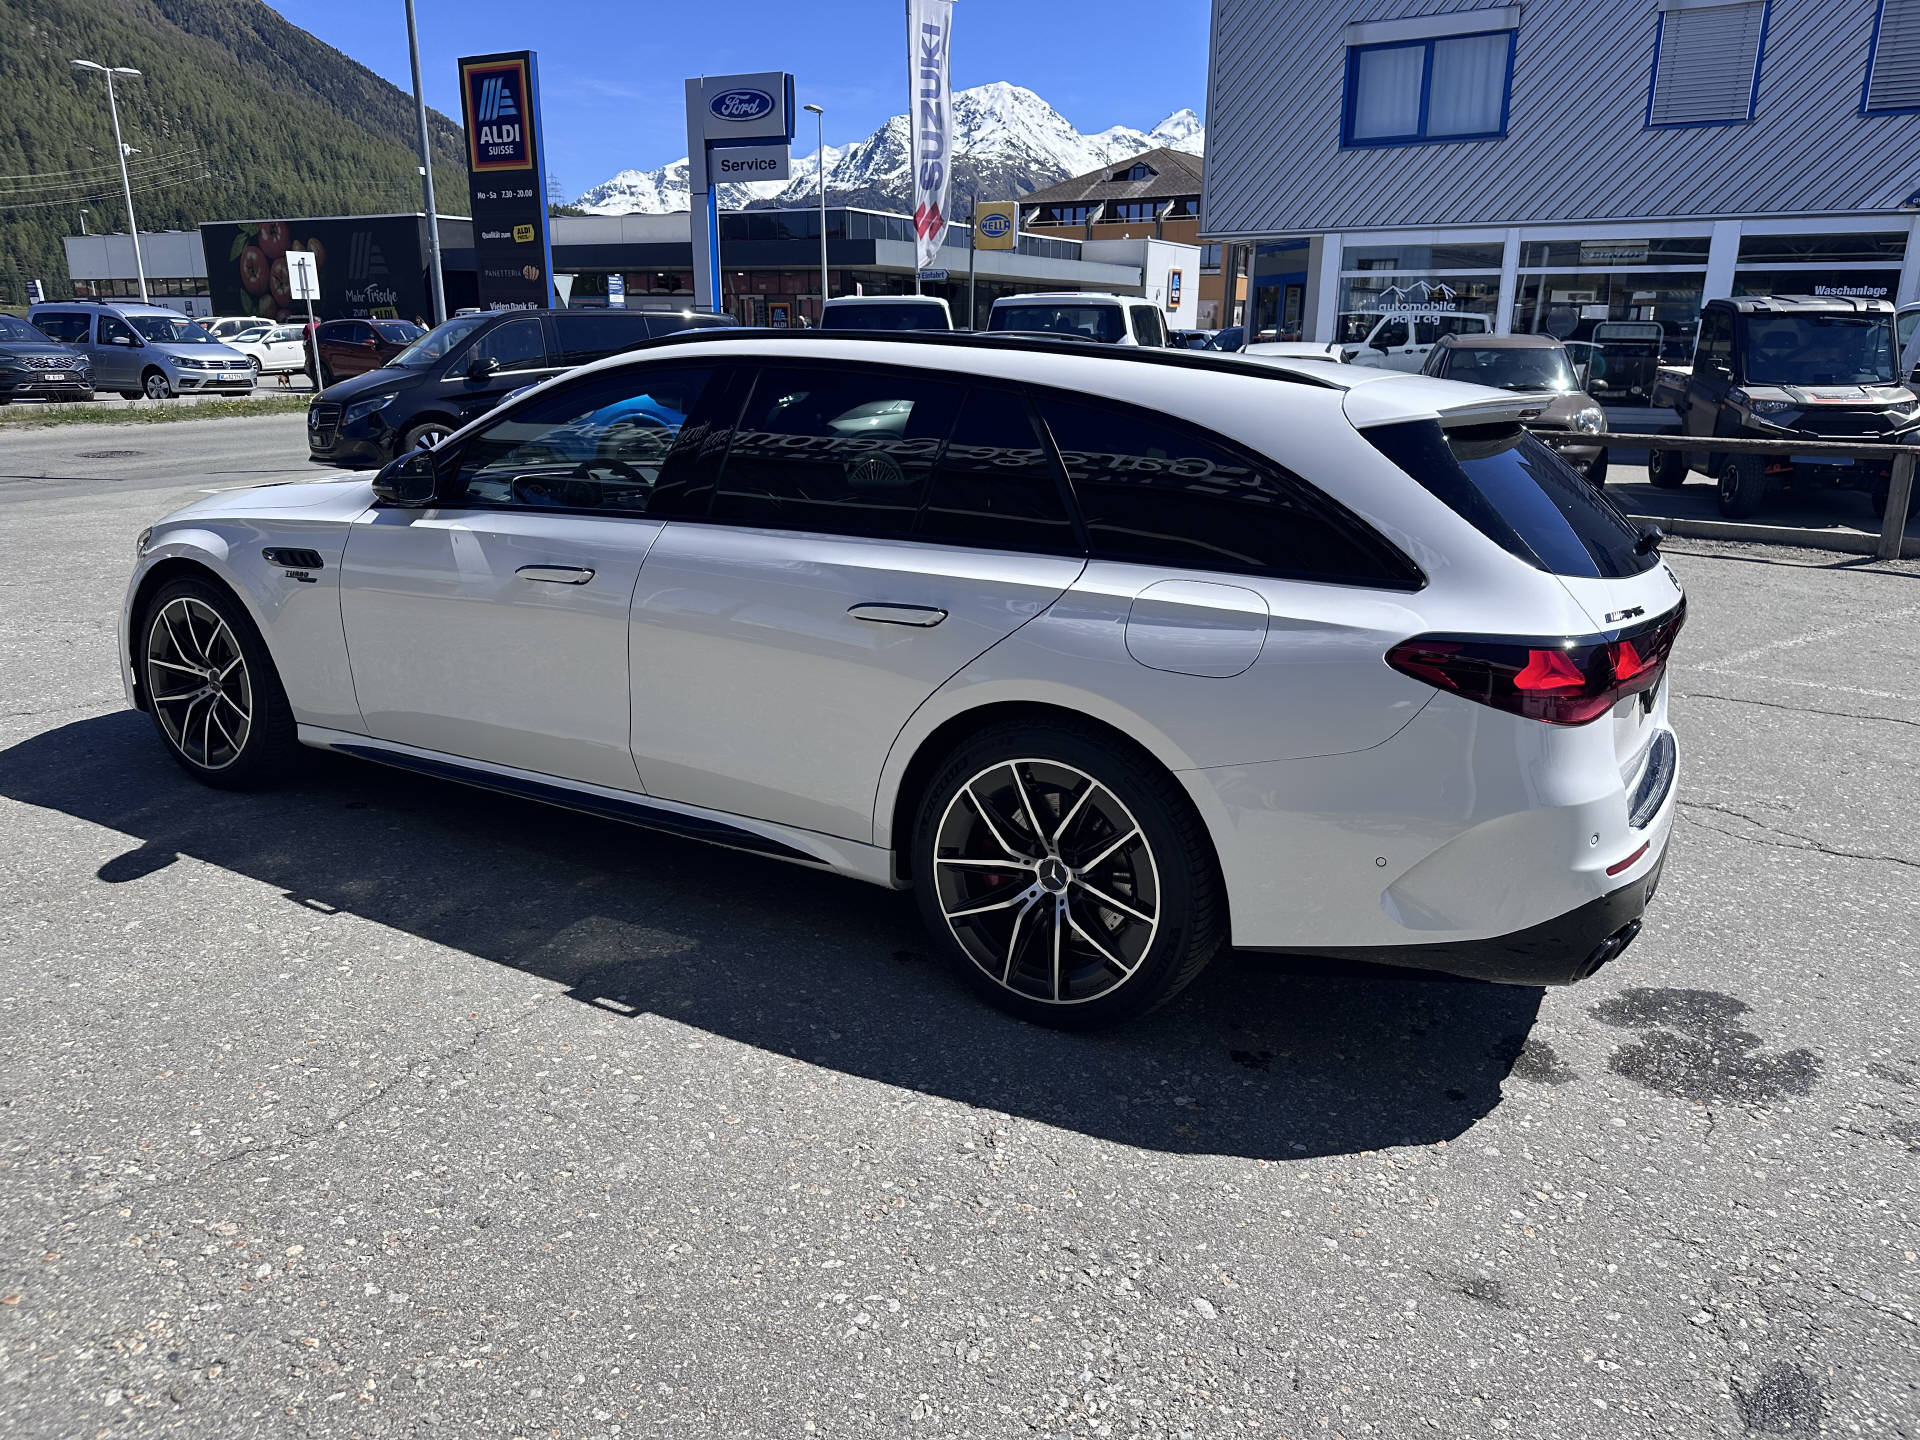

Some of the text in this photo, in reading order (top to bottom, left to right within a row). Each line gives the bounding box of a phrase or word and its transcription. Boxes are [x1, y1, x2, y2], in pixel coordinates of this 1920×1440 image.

[721, 94, 760, 115] Ford
[920, 22, 944, 192] SUZUKI
[480, 124, 520, 144] ALDI
[488, 145, 515, 156] SUISSE
[721, 158, 777, 172] Service
[517, 227, 531, 235] ALDI
[980, 218, 1012, 234] HELLA
[921, 272, 946, 280] Einfahrt
[363, 283, 398, 305] Frische
[1815, 285, 1888, 298] Waschanlage
[489, 302, 511, 311] Vielen
[1379, 302, 1456, 312] automobile
[1423, 315, 1440, 325] ag
